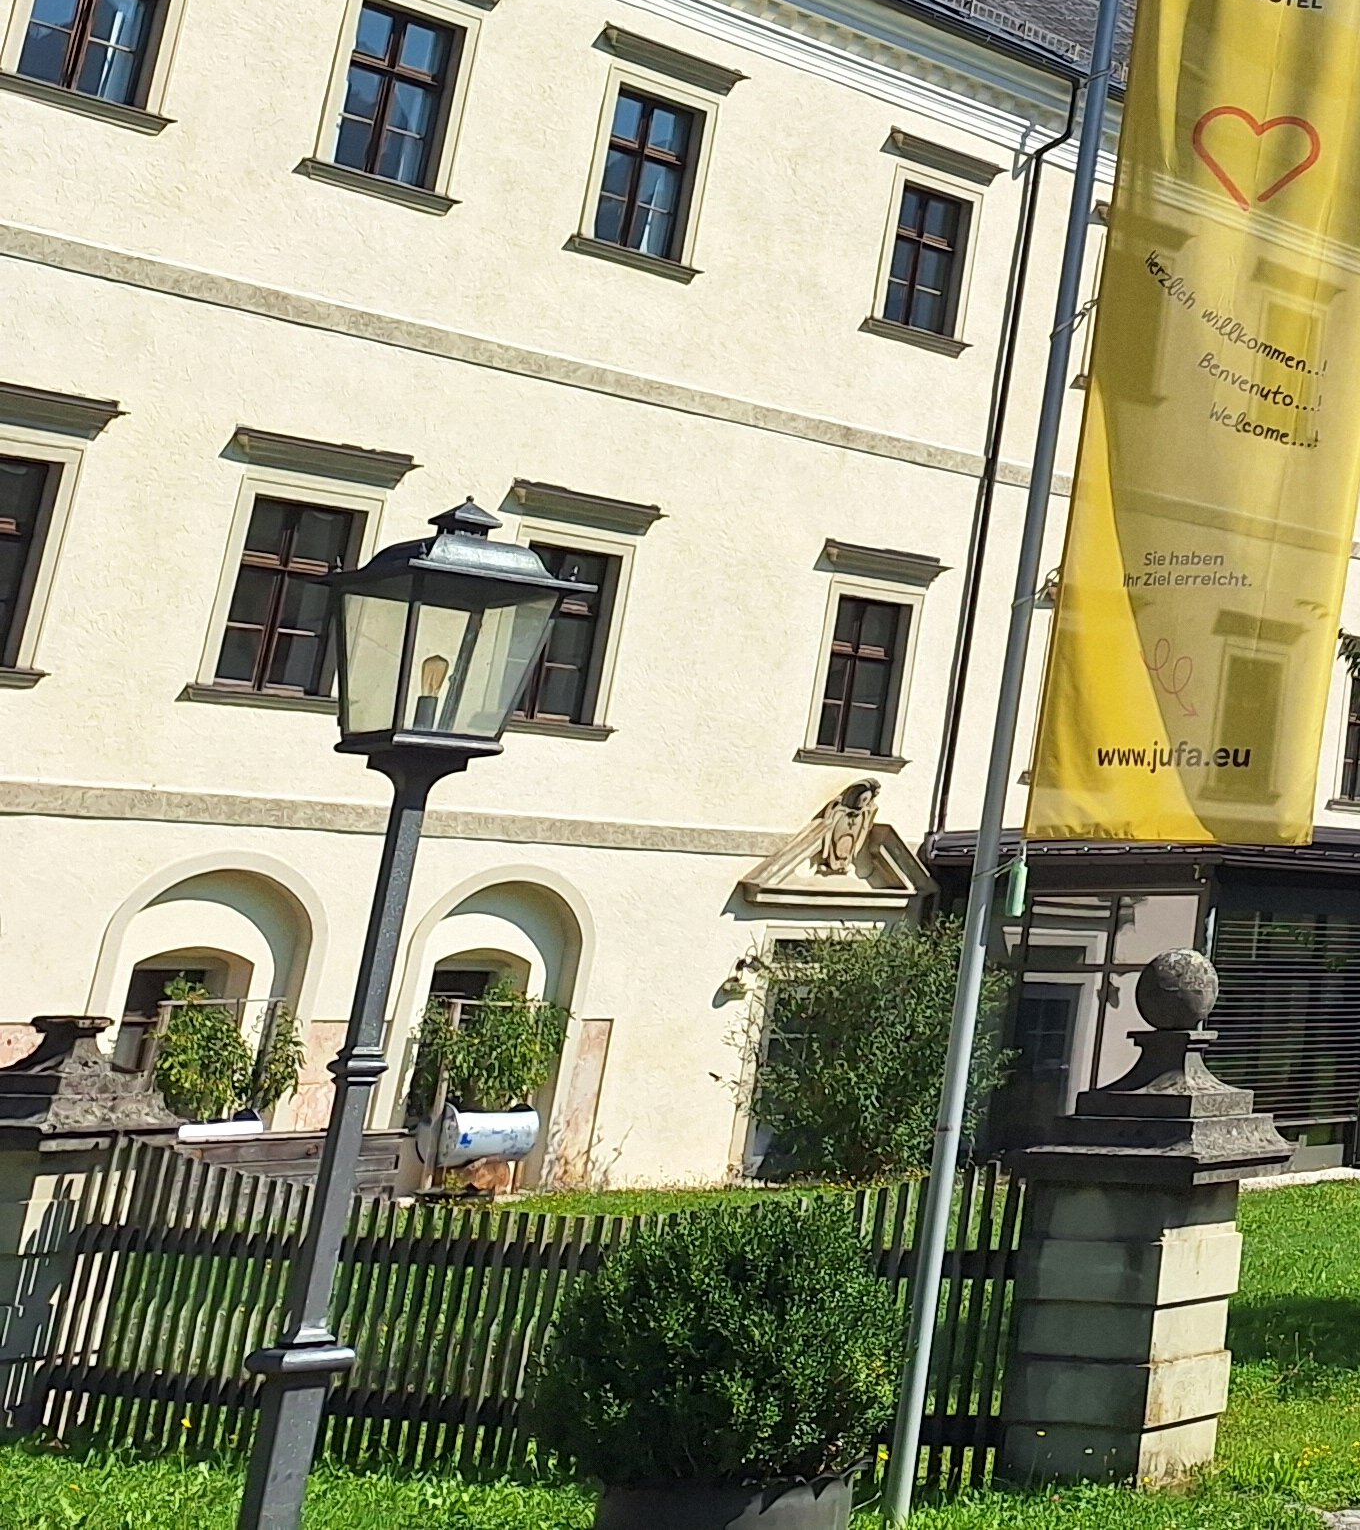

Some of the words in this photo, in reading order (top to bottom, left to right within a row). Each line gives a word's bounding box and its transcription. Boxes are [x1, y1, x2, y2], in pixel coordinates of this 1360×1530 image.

[1145, 250, 1196, 309] Herzlich
[1143, 551, 1166, 566] Sie
[1169, 551, 1224, 566] haben
[1123, 572, 1140, 587] Ihr
[1143, 572, 1171, 586] Ziel
[1175, 572, 1252, 587] erreicht.
[1097, 740, 1252, 774] www.jufa.eu
